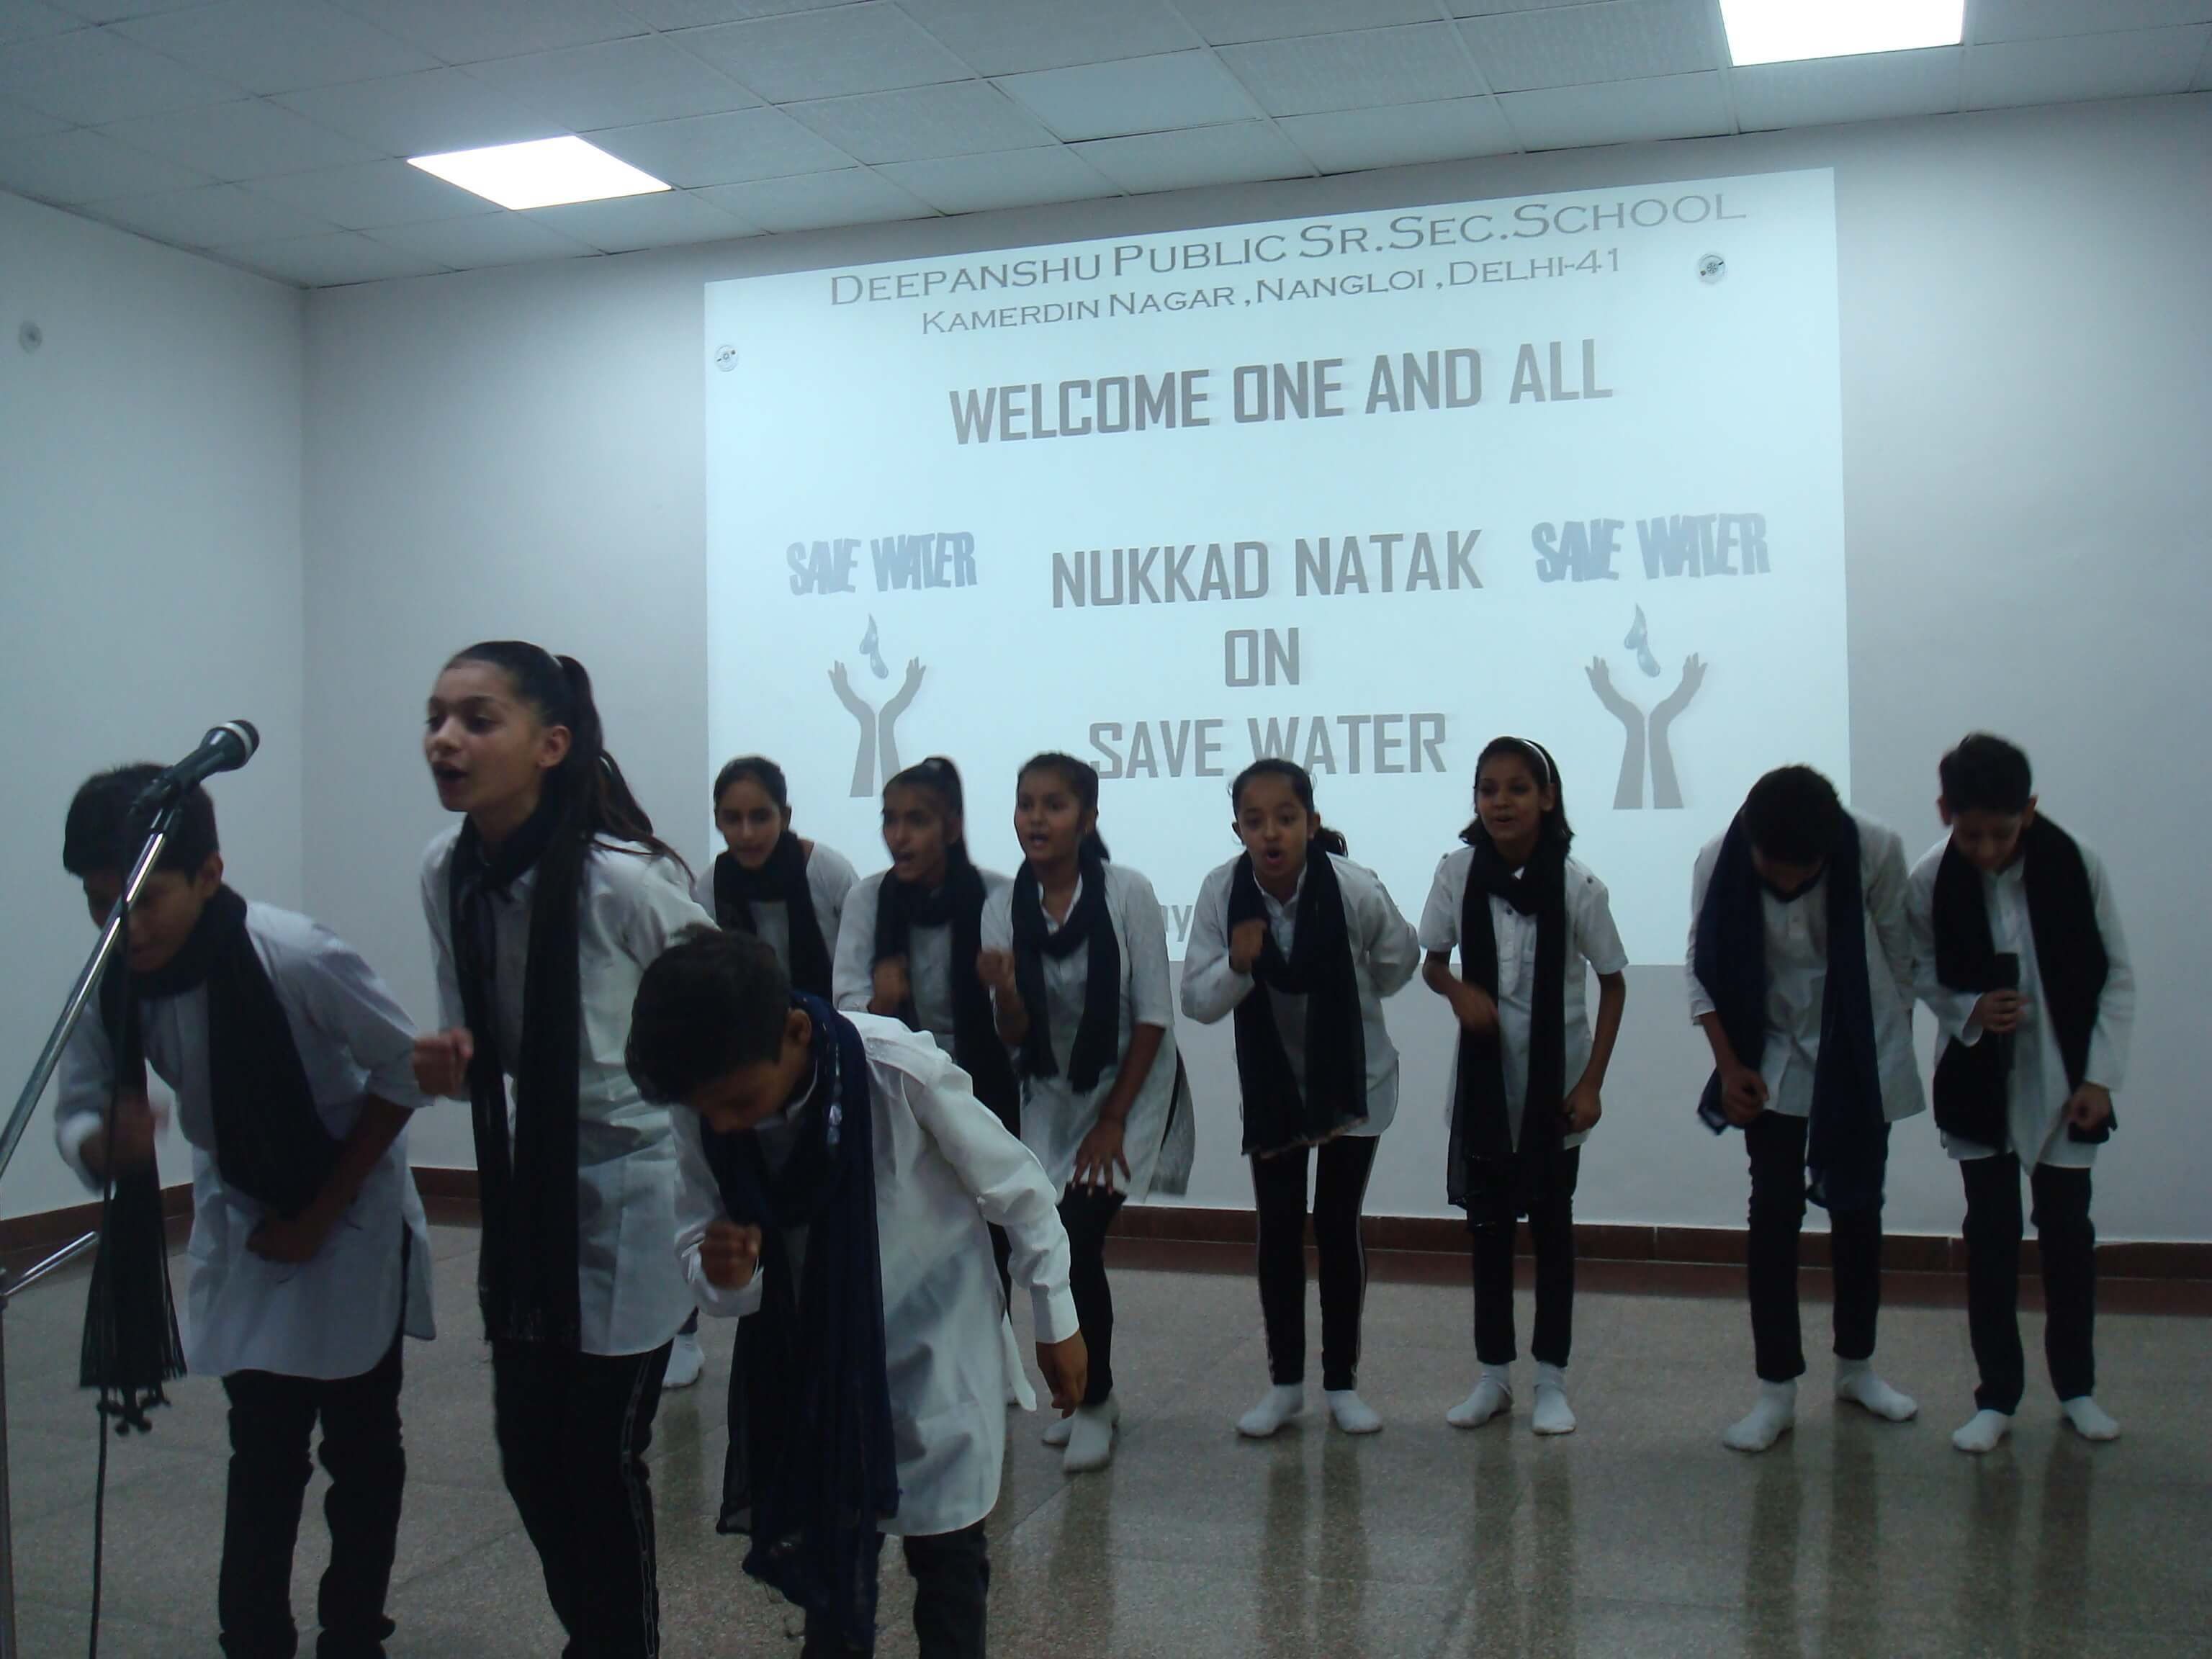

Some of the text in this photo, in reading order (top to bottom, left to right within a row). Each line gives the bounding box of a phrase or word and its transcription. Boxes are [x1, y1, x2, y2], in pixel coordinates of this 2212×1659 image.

[831, 253, 1101, 306] DEEPANSHU
[1113, 234, 1287, 277] PUBLIC
[922, 299, 1101, 335] KAMERDIN
[949, 338, 1614, 445] WELCOME ONE AND ALL
[786, 531, 979, 596] SAVE WATER
[1052, 529, 1484, 609] NUKKAD NATAK
[1531, 513, 1771, 583] SAVE WATER
[1224, 626, 1300, 688] ON
[1089, 713, 1447, 781] SAVE WATER
